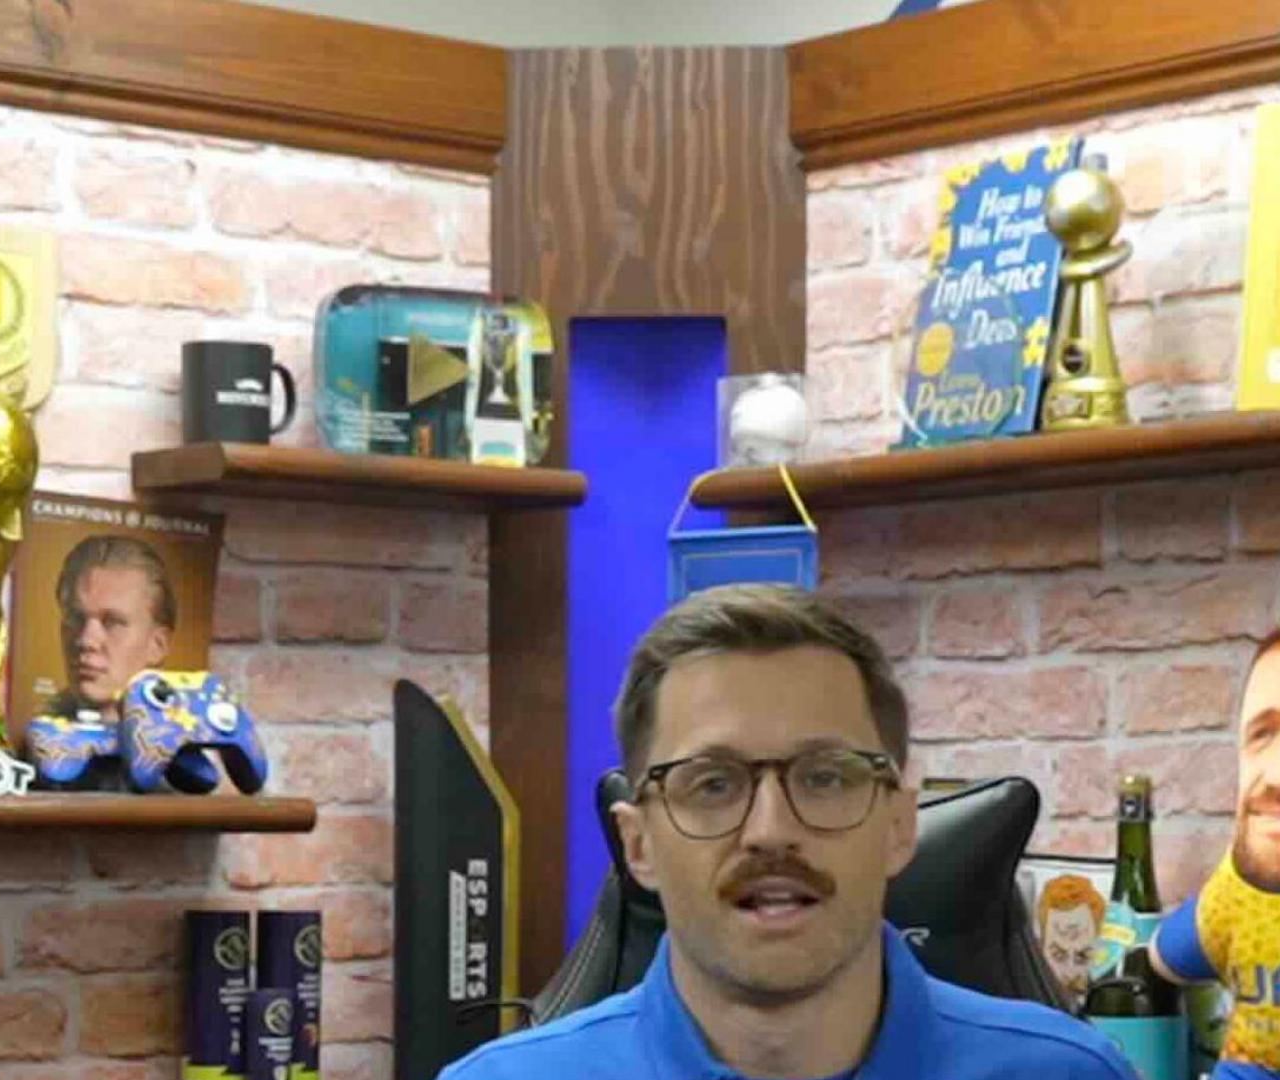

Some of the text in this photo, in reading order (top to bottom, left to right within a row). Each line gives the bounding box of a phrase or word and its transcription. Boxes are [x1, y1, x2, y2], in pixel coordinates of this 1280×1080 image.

[930, 259, 1047, 318] Influence
[32, 499, 210, 536] CHAMPIONS JOURNAL
[467, 858, 488, 1000] ESPRTS
